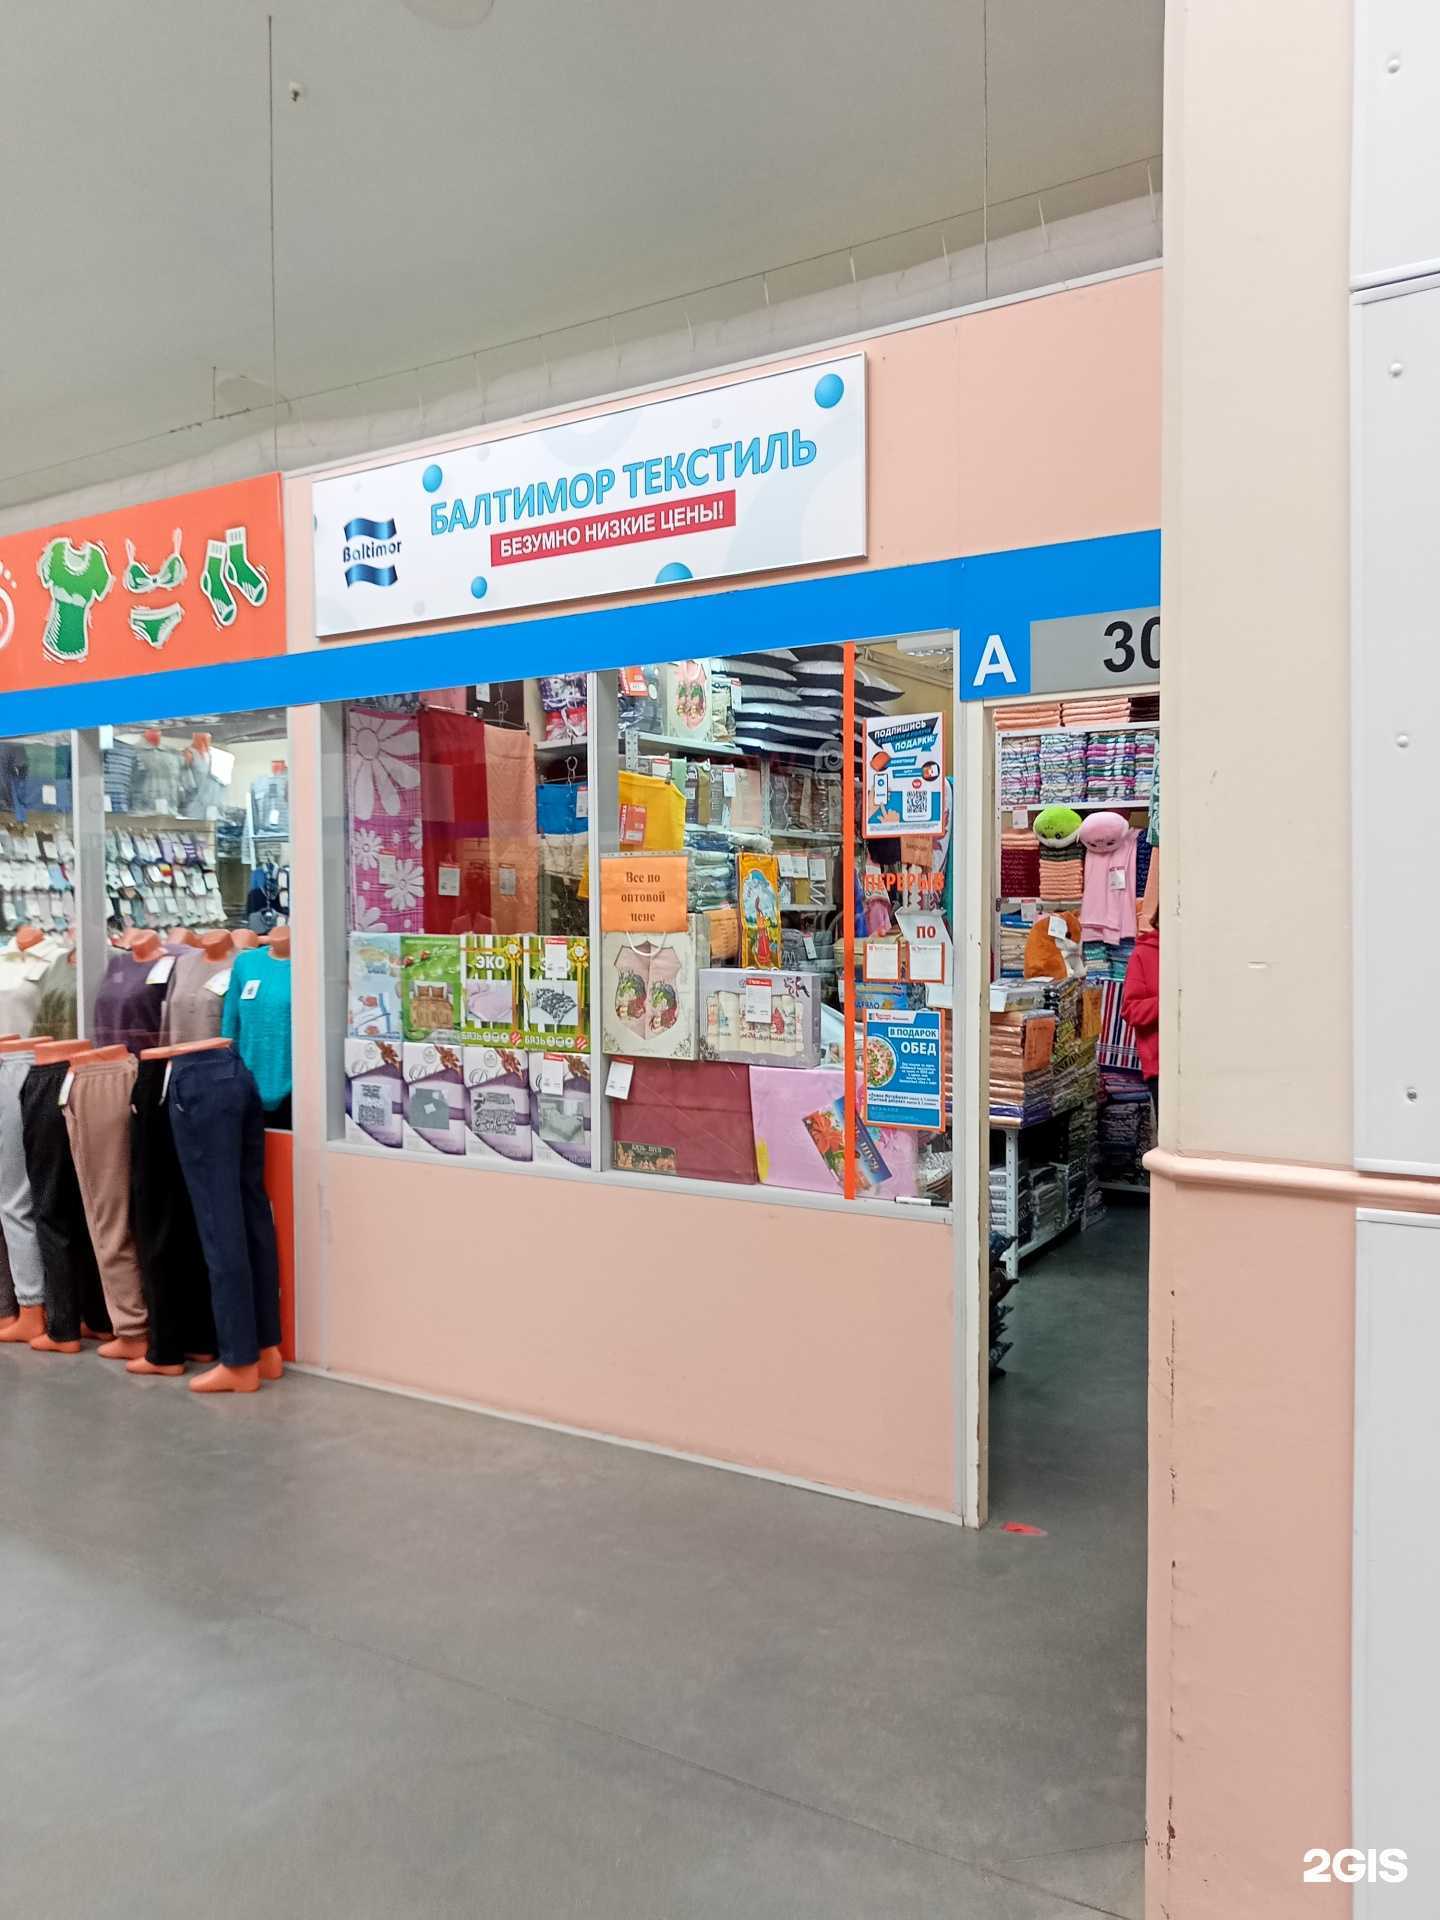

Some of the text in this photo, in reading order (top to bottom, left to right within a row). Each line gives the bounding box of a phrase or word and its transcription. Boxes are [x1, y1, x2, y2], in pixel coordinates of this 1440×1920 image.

[430, 428, 817, 536] БАЛТИМОР ТЕКСТИЛЬ
[500, 500, 724, 557] БЕЗУМНО НИЗКИЕ ЦЕНЫ!
[343, 540, 402, 563] Baltimor
[874, 719, 927, 739] ПОДПИШИСЬ
[626, 871, 661, 883] Все по
[863, 872, 945, 892] ПЕРЕРЫВ
[620, 890, 666, 903] оптовой
[631, 912, 656, 923] цене
[916, 926, 937, 939] ПО
[475, 955, 506, 970] ЭКО
[889, 1028, 937, 1039] В ПОДАРОК
[900, 1041, 937, 1057] ОБЕД
